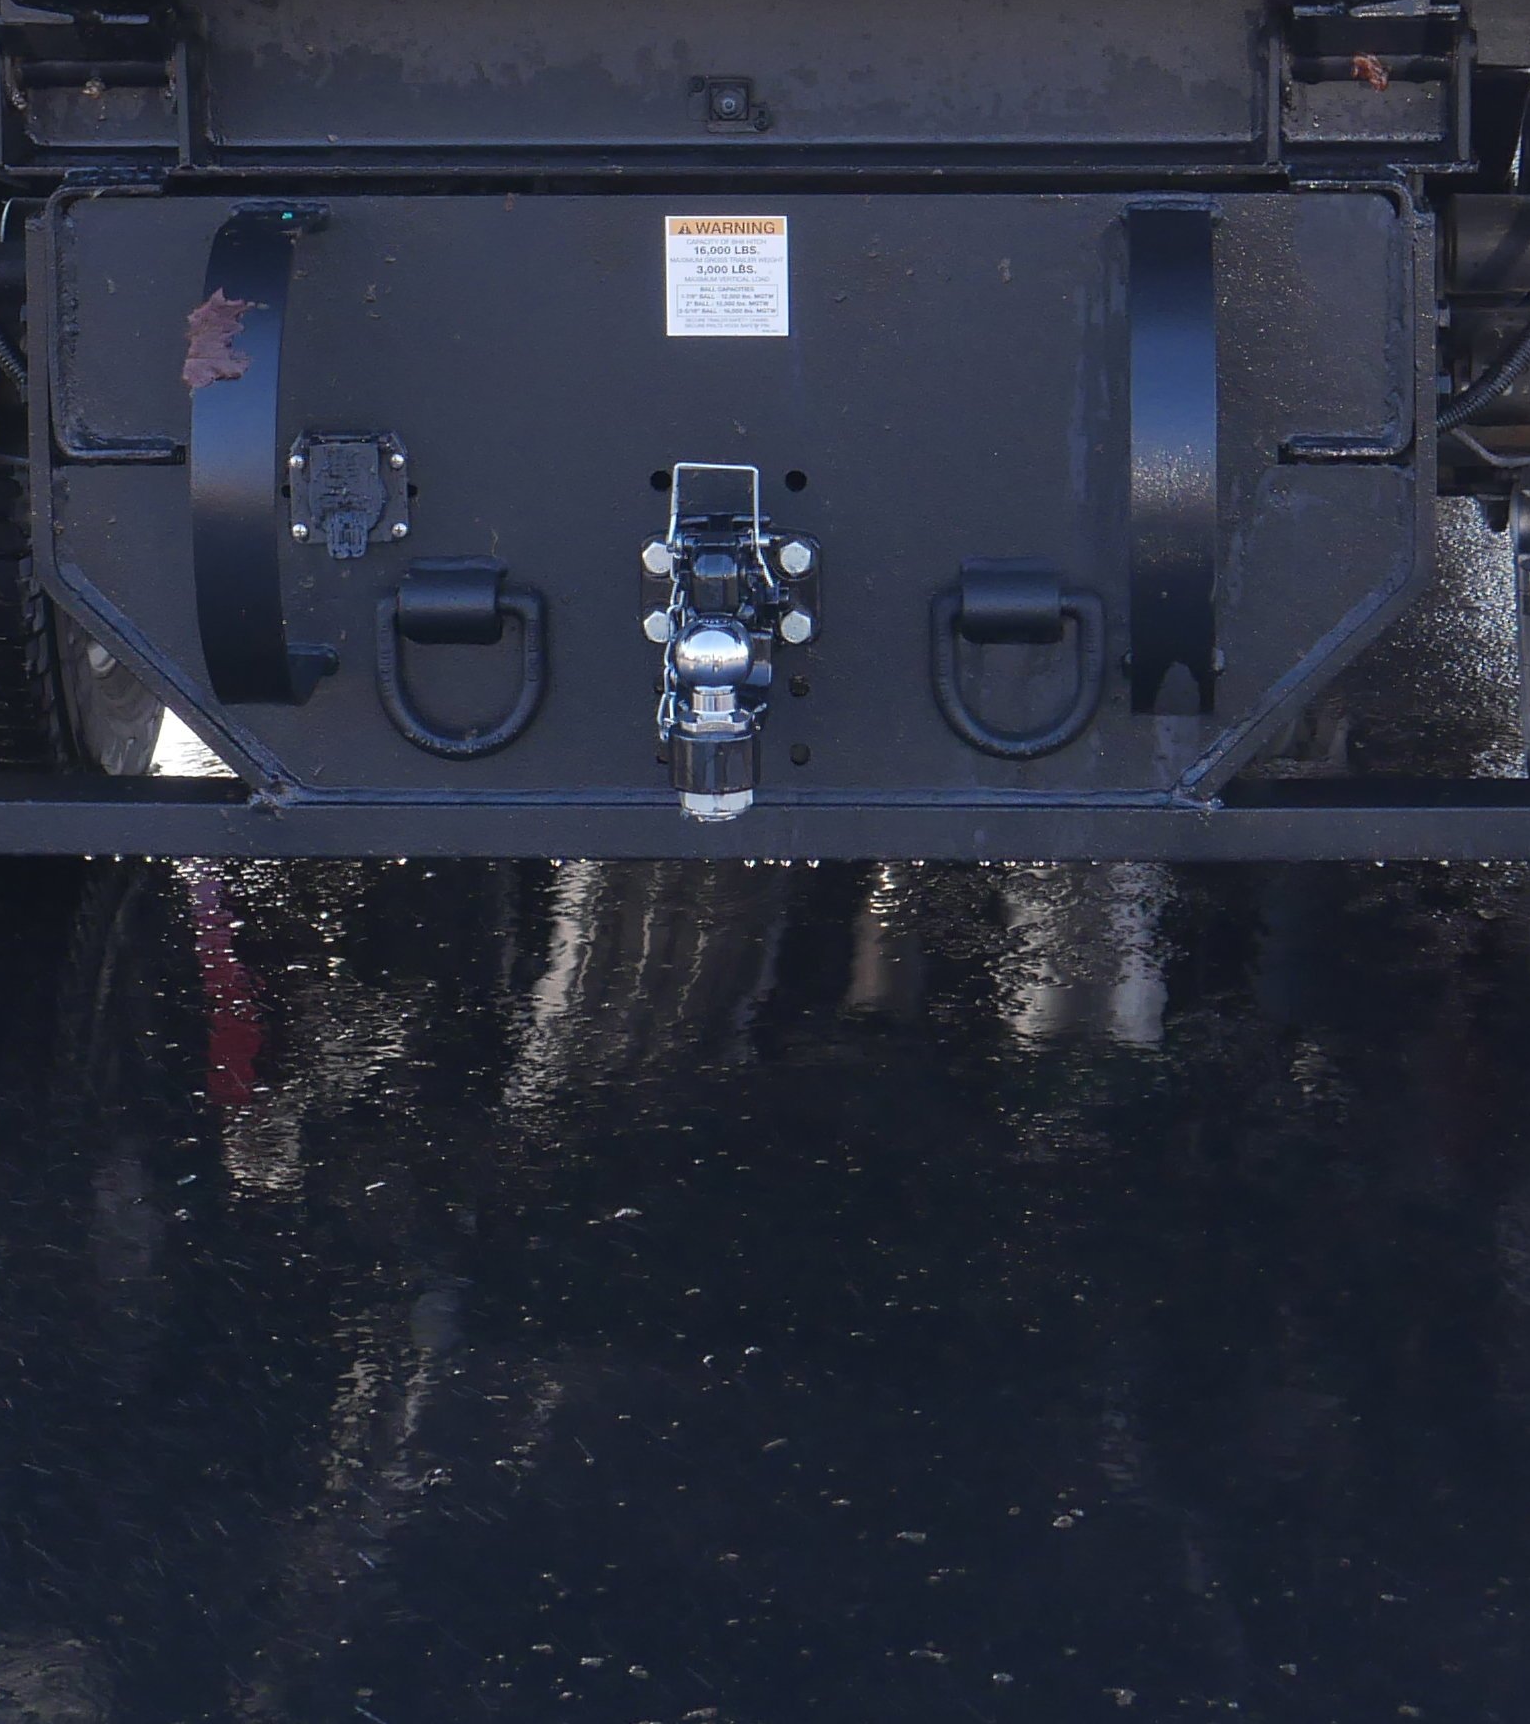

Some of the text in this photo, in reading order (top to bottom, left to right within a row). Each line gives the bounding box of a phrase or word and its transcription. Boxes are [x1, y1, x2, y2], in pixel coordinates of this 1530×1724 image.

[696, 221, 775, 235] WARNING
[694, 246, 760, 256] 16,000 LBS.
[696, 265, 757, 275] 3,000 LBS.
